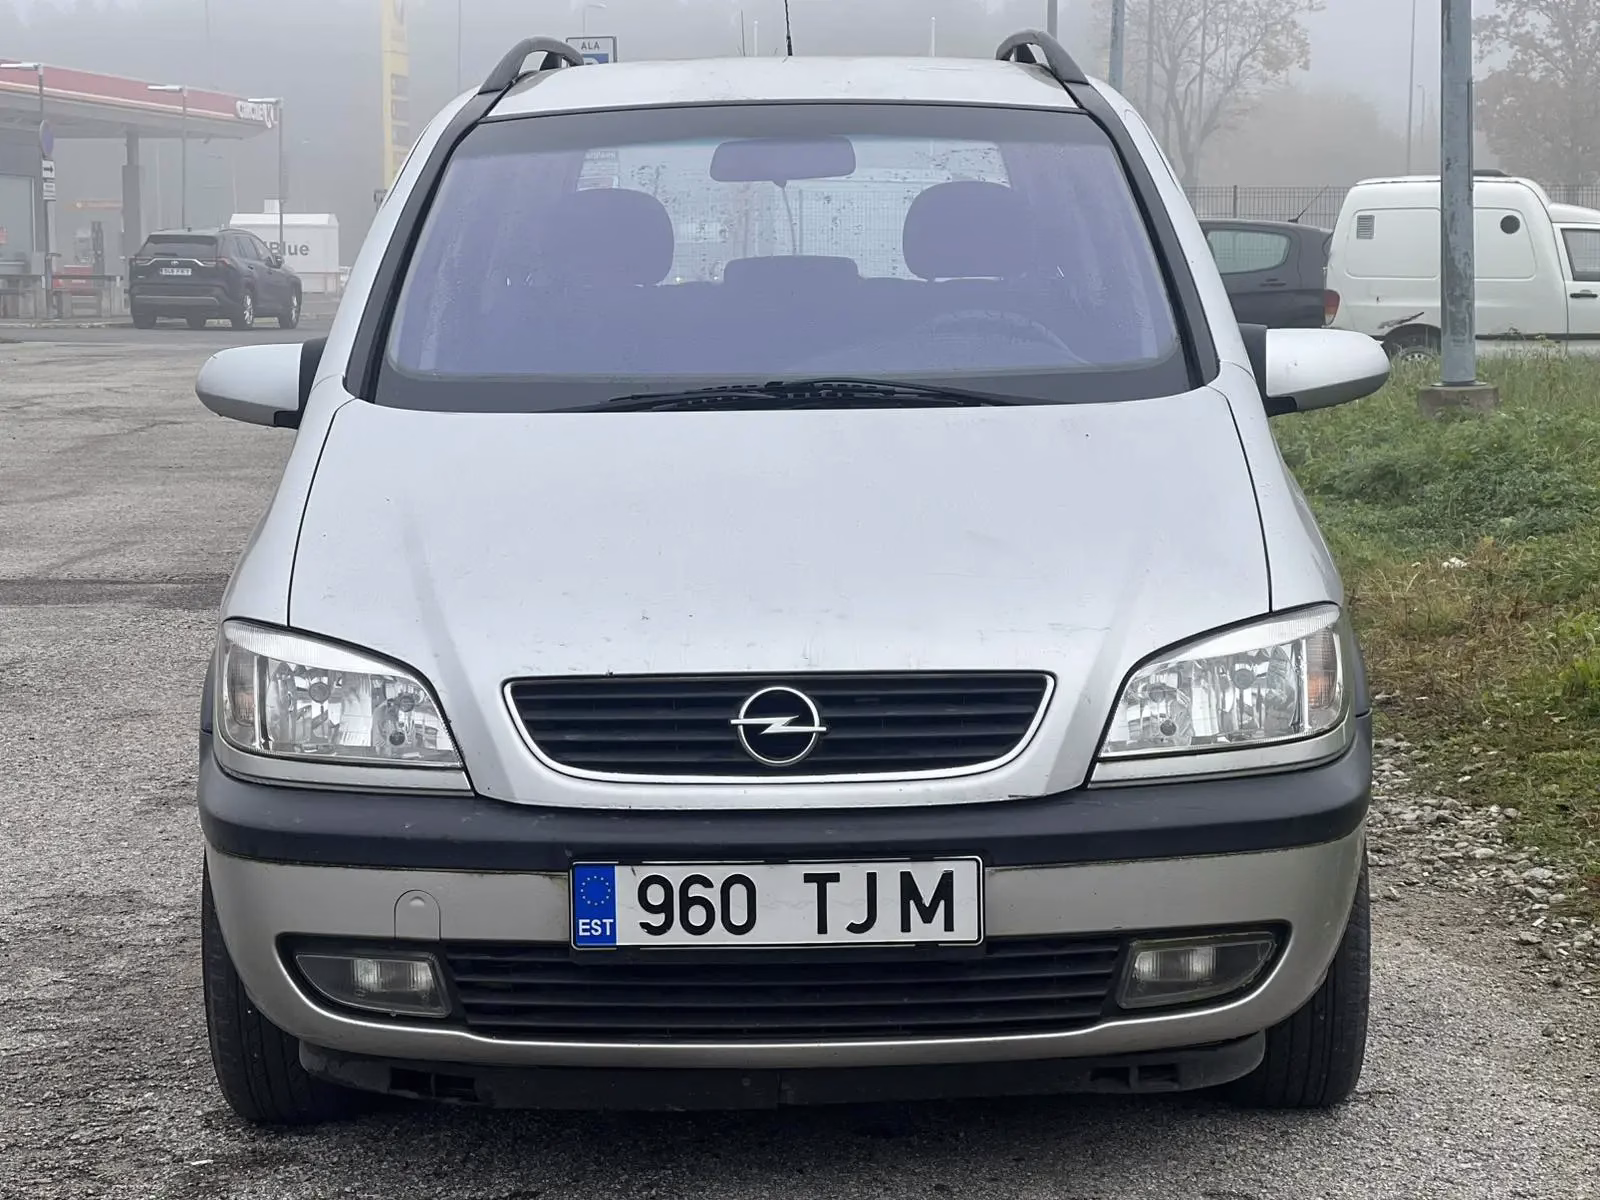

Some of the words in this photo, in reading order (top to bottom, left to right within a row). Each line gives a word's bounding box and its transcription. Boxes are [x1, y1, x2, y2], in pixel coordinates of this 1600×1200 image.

[580, 41, 600, 50] ALA
[637, 873, 757, 936] 960
[803, 870, 955, 935] TJM
[578, 919, 614, 936] EST
